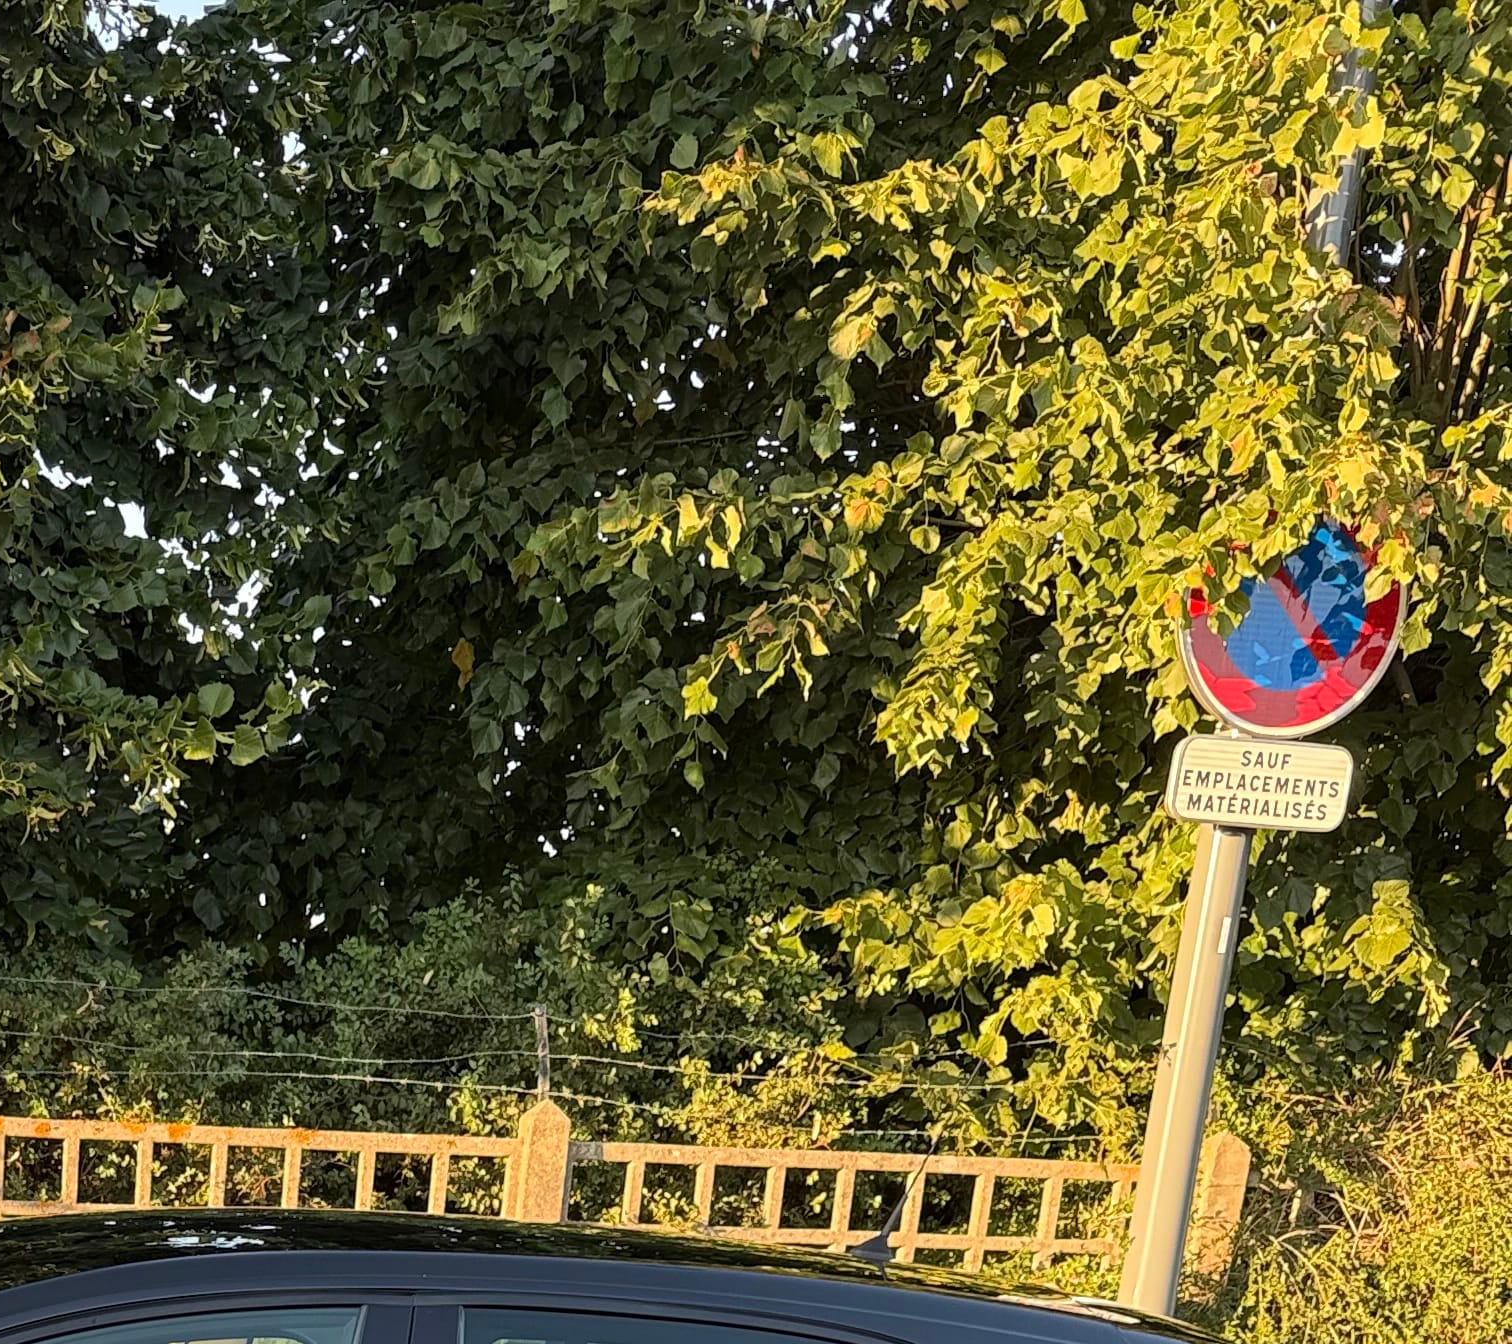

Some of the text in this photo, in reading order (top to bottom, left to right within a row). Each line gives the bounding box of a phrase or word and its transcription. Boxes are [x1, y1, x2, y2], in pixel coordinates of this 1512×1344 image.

[1240, 750, 1292, 771] SAUF
[1182, 769, 1340, 799] EMPLACEMENTS
[1186, 793, 1328, 821] MATÉRIALISÉS
